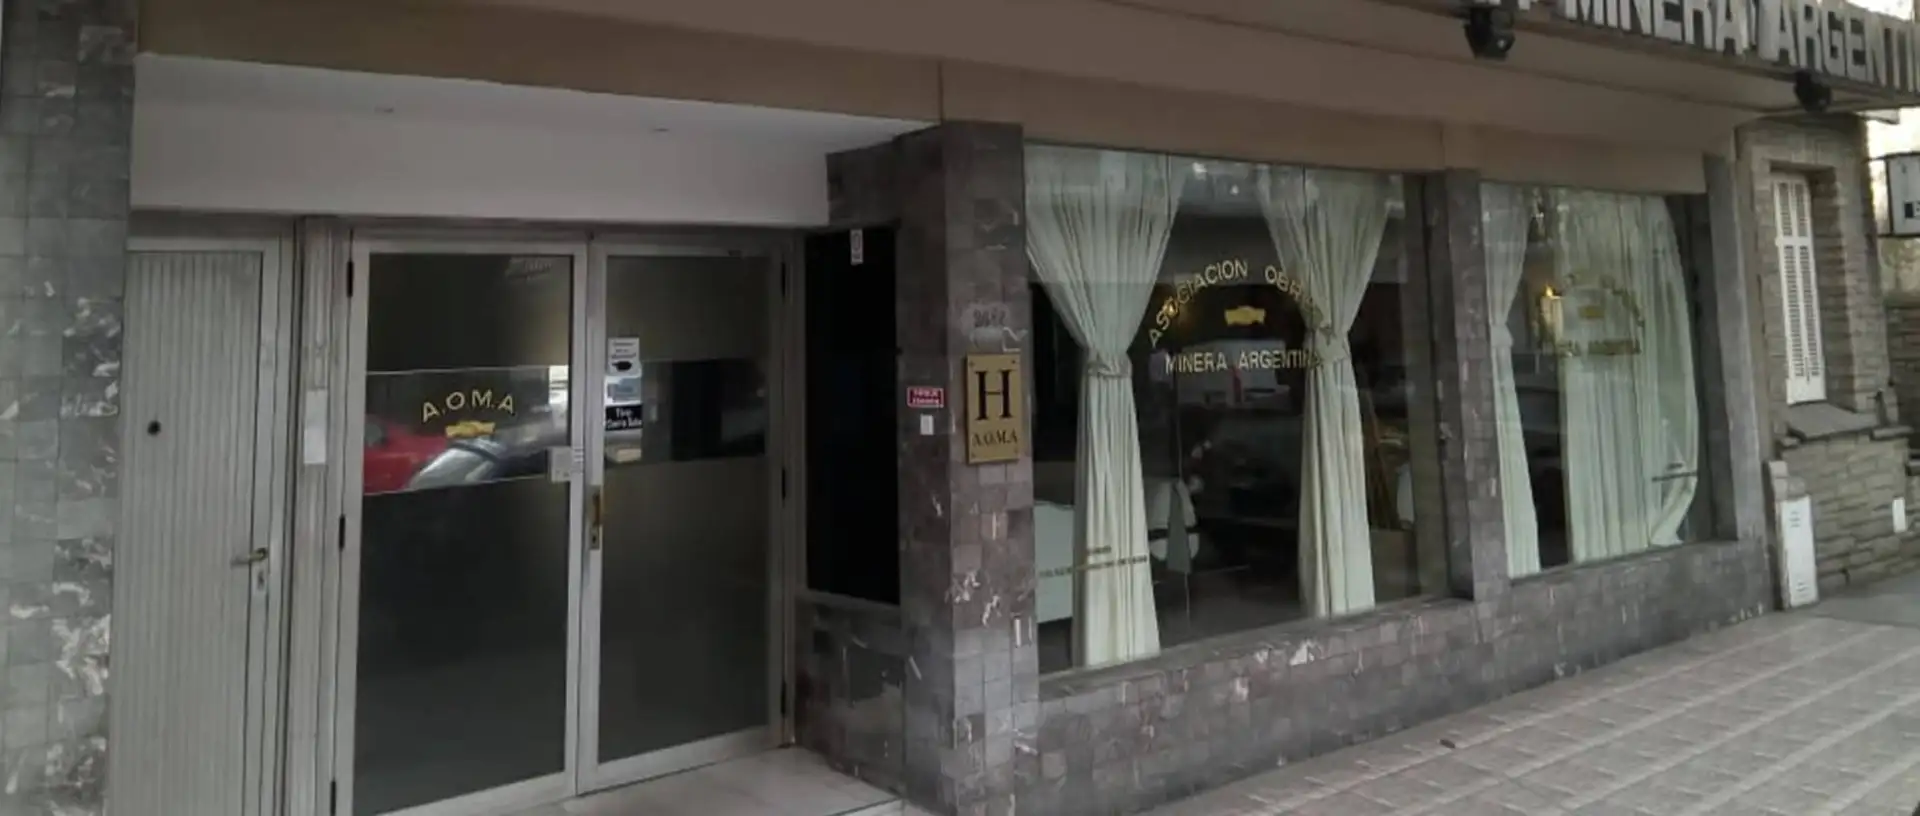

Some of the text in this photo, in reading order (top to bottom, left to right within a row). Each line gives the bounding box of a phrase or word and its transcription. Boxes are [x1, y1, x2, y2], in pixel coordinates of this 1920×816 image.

[1565, 0, 1920, 91] NERA ARGENTI
[1149, 259, 1248, 348] ASOCIACION
[974, 369, 1013, 421] H
[1165, 351, 1228, 375] MINERA
